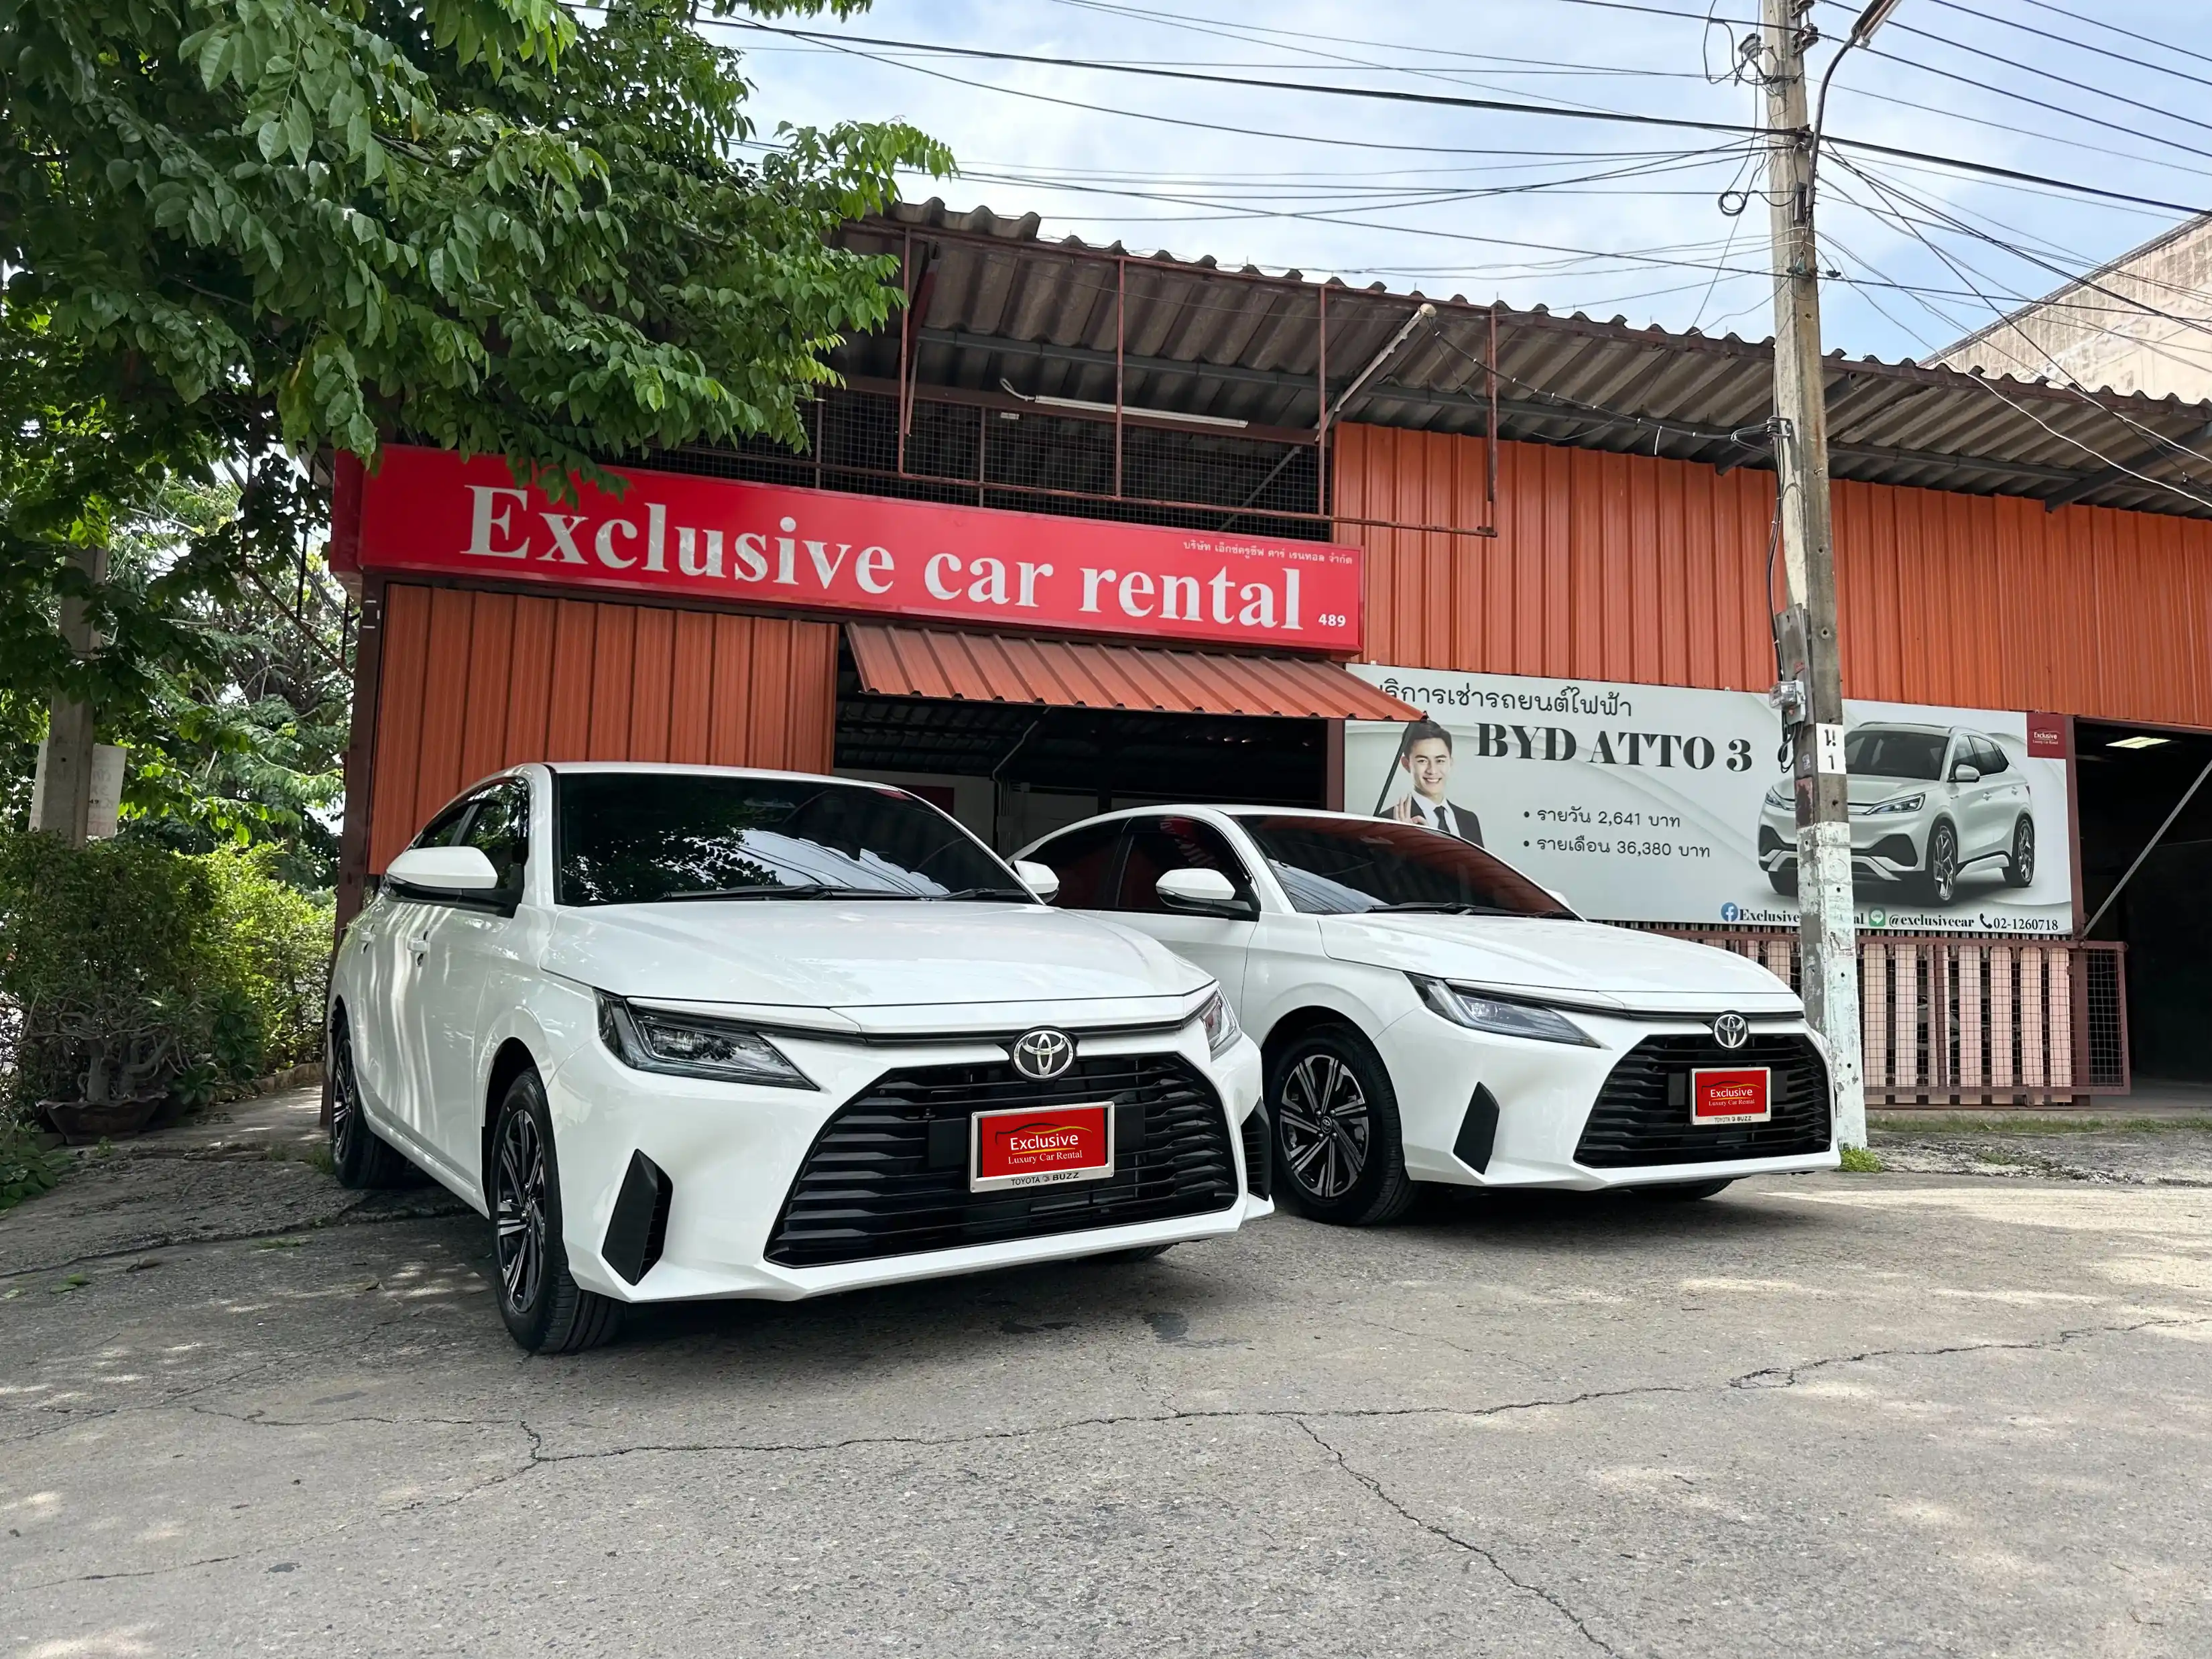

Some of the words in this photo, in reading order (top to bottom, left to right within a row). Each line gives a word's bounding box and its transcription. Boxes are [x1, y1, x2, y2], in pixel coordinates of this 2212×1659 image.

[460, 483, 895, 592] Exclusive
[924, 552, 1054, 608] car
[1078, 565, 1304, 631] rental
[1183, 539, 1211, 551] บริษัท
[1329, 552, 1353, 564] จำกัด
[1318, 613, 1347, 627] 489
[1379, 677, 1632, 717] ริการเช่ารถยนต์ไฟฟ้า
[1475, 723, 1577, 761] BYD
[1588, 731, 1716, 770] ATTO
[1726, 739, 1752, 772] 3
[1537, 806, 1591, 823] รายวัน
[1598, 811, 1640, 826] 2,641
[1648, 815, 1681, 828] บาท
[1536, 835, 1611, 853] รายเดือน
[1617, 841, 1672, 857] 36,380
[1678, 845, 1710, 857] บาท
[1739, 908, 1801, 923] Exclusive
[1993, 918, 2059, 931] 02-1260718
[1710, 1087, 1754, 1097] Exclusive
[1009, 1133, 1079, 1151] Exclusive
[1007, 1154, 1038, 1164] Luxury
[1039, 1152, 1054, 1162] Car
[1056, 1150, 1083, 1160] Rental
[1011, 1176, 1040, 1186] TOYOTA
[1052, 1172, 1080, 1181] BUZZ
